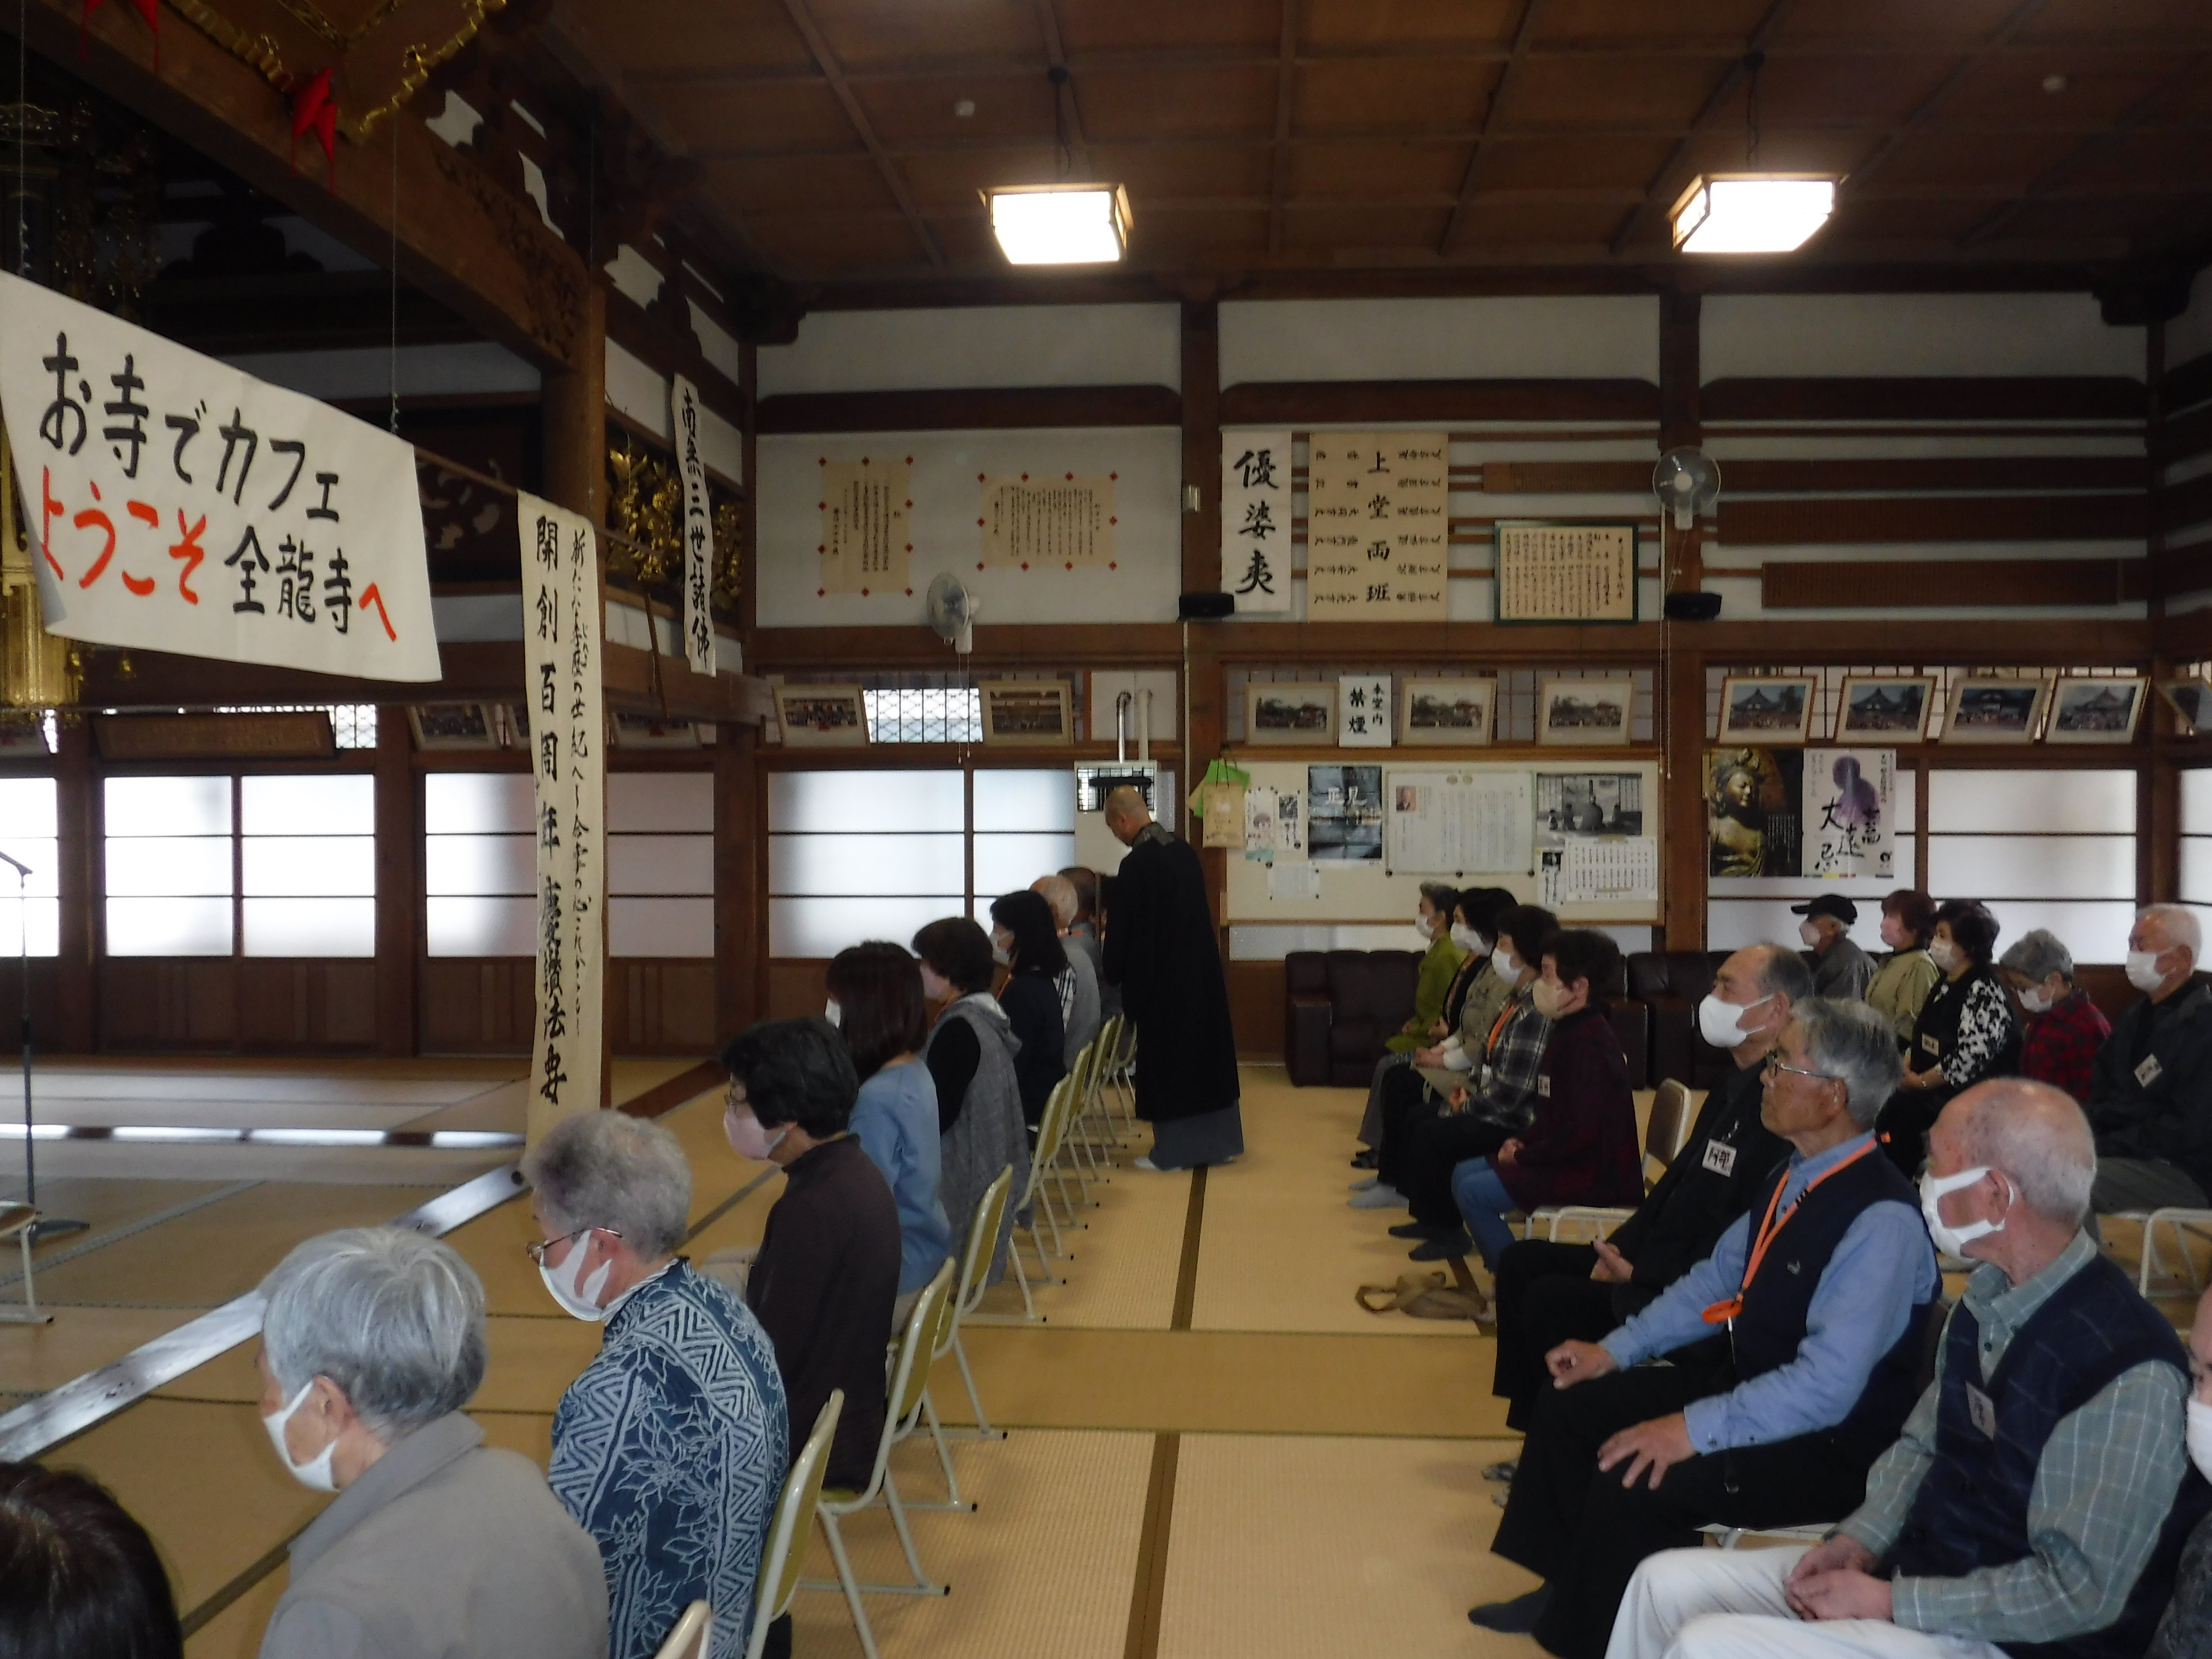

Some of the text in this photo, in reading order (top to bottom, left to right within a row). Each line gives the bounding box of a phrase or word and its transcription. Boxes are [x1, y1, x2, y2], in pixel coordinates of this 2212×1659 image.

[39, 331, 339, 522] お寺でカフェ
